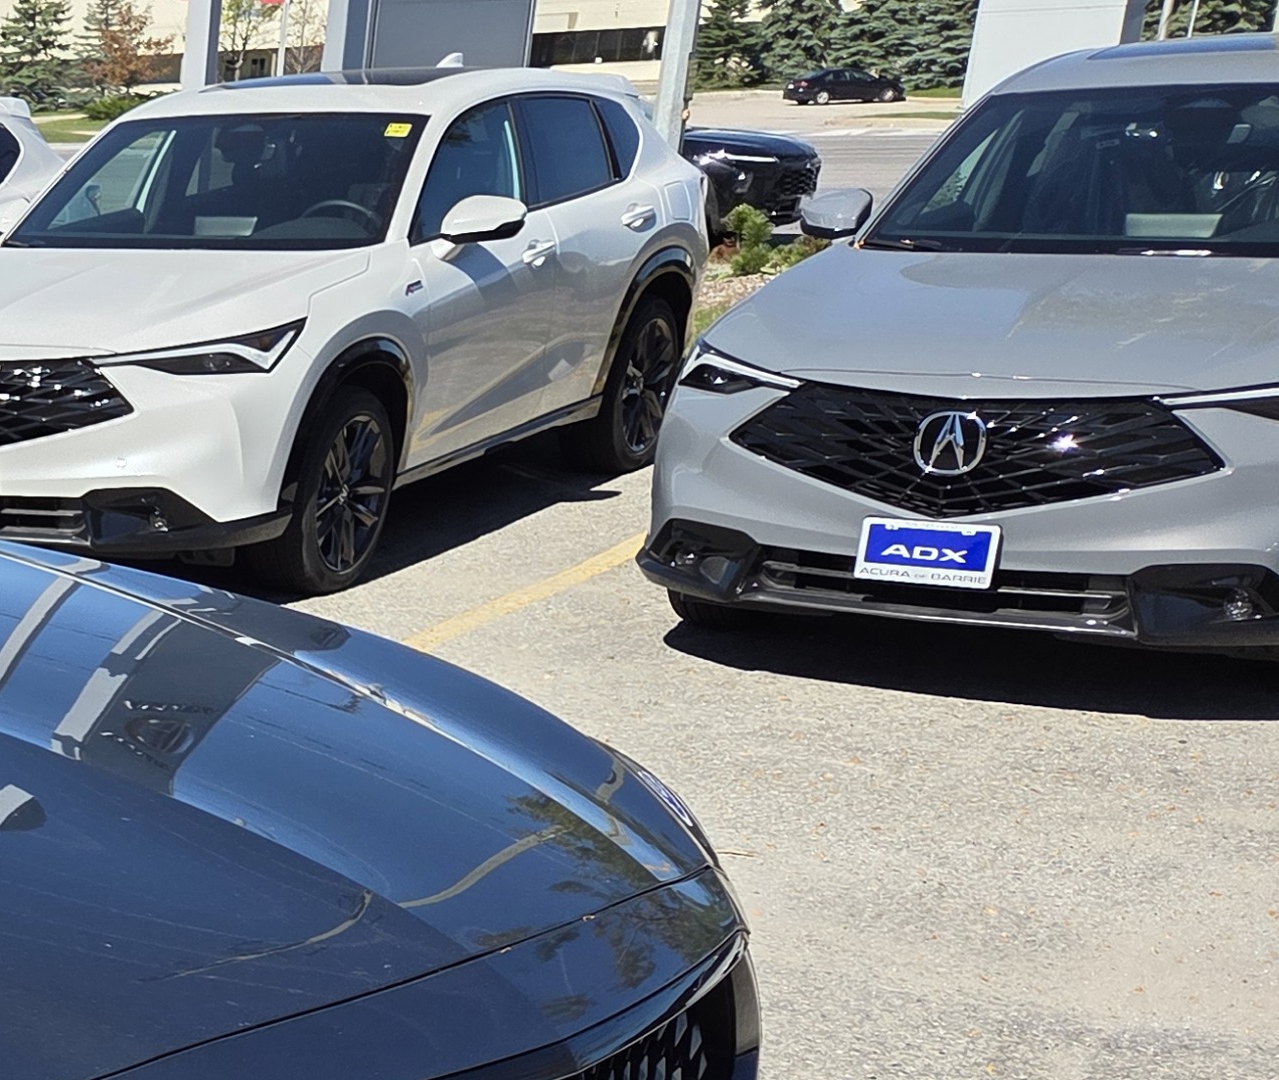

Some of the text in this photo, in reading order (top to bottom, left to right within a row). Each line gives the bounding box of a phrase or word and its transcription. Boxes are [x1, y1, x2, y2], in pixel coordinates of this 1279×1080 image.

[880, 544, 968, 564] ADX
[859, 567, 911, 578] ACURA
[931, 573, 988, 585] BARRIE
